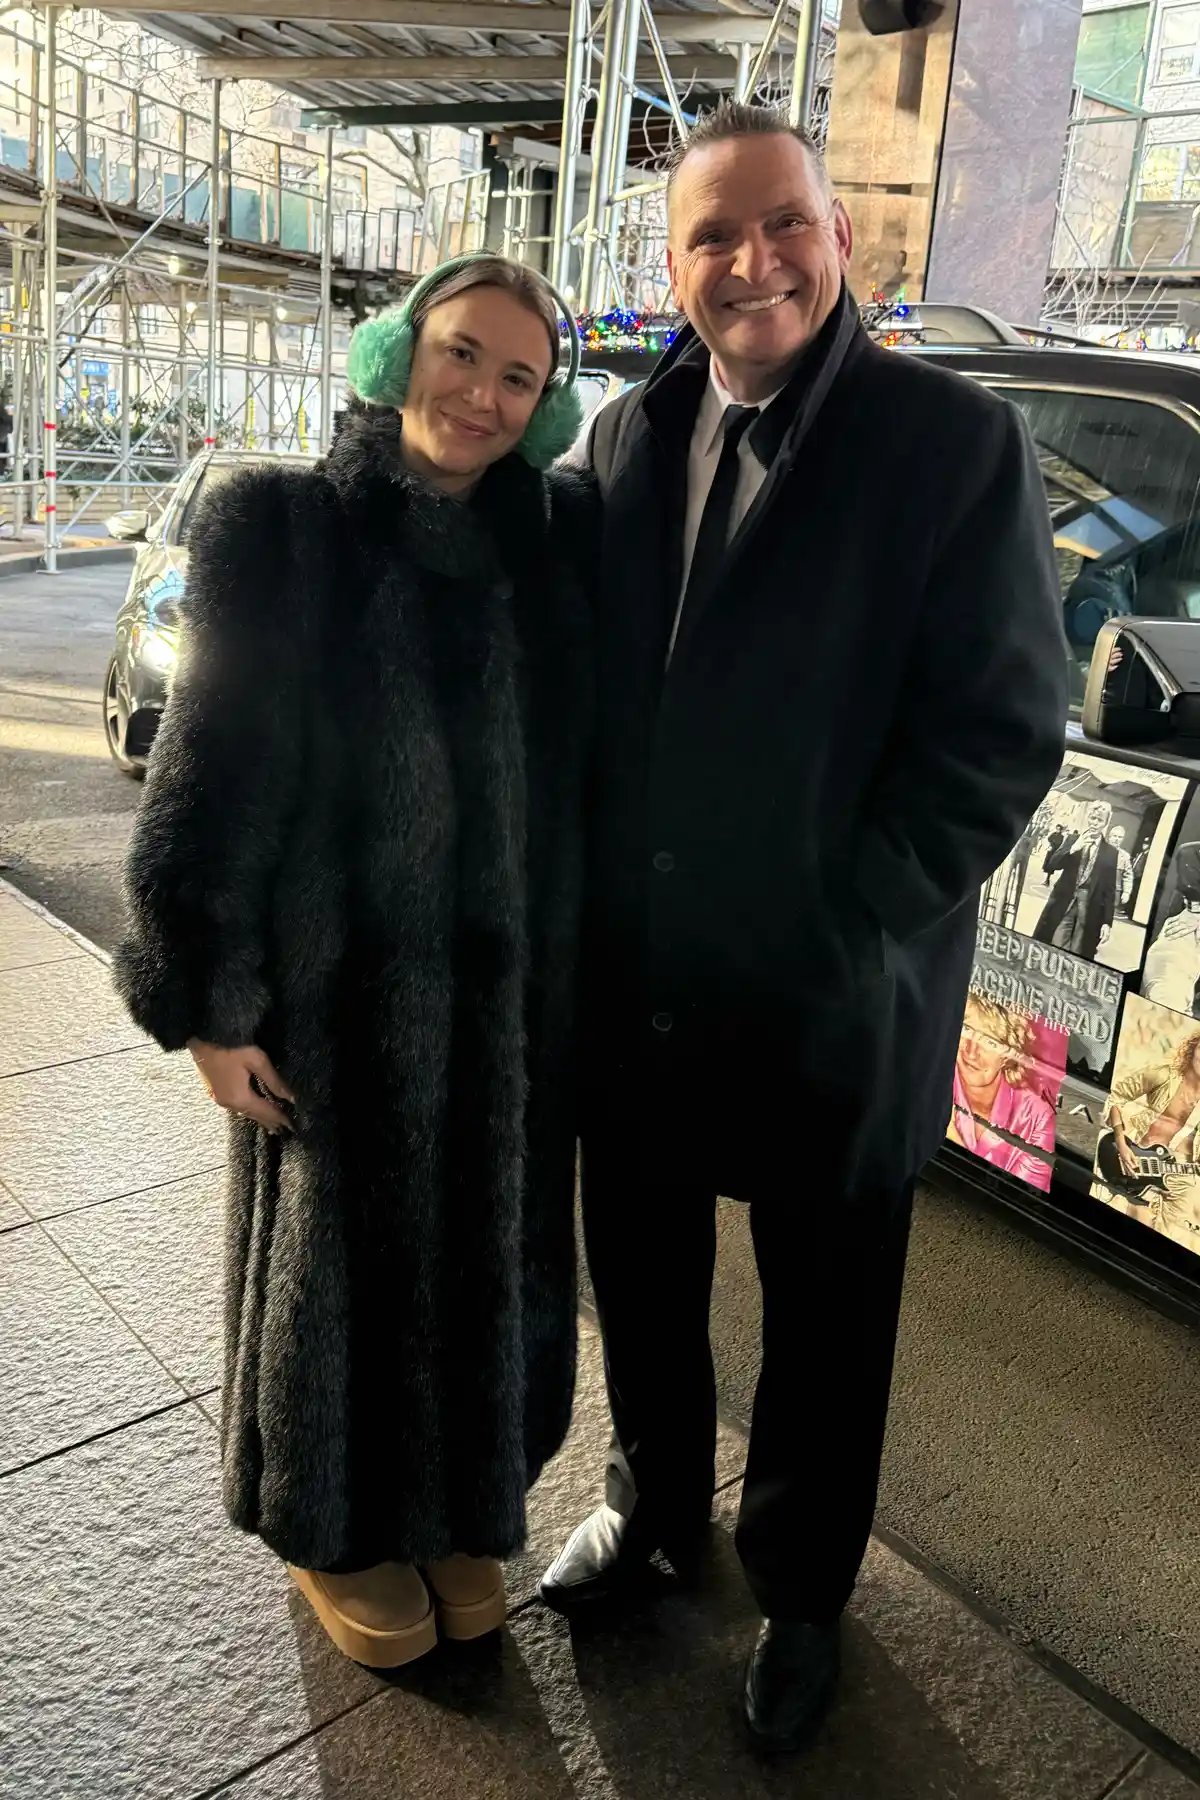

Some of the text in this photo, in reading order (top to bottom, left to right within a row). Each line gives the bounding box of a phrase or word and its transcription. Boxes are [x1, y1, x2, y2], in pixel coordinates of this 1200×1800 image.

[969, 963, 1111, 1044] ACHINE HEAD
[976, 925, 1121, 1004] EEP PURPLE
[1043, 1017, 1071, 1037] HITS
